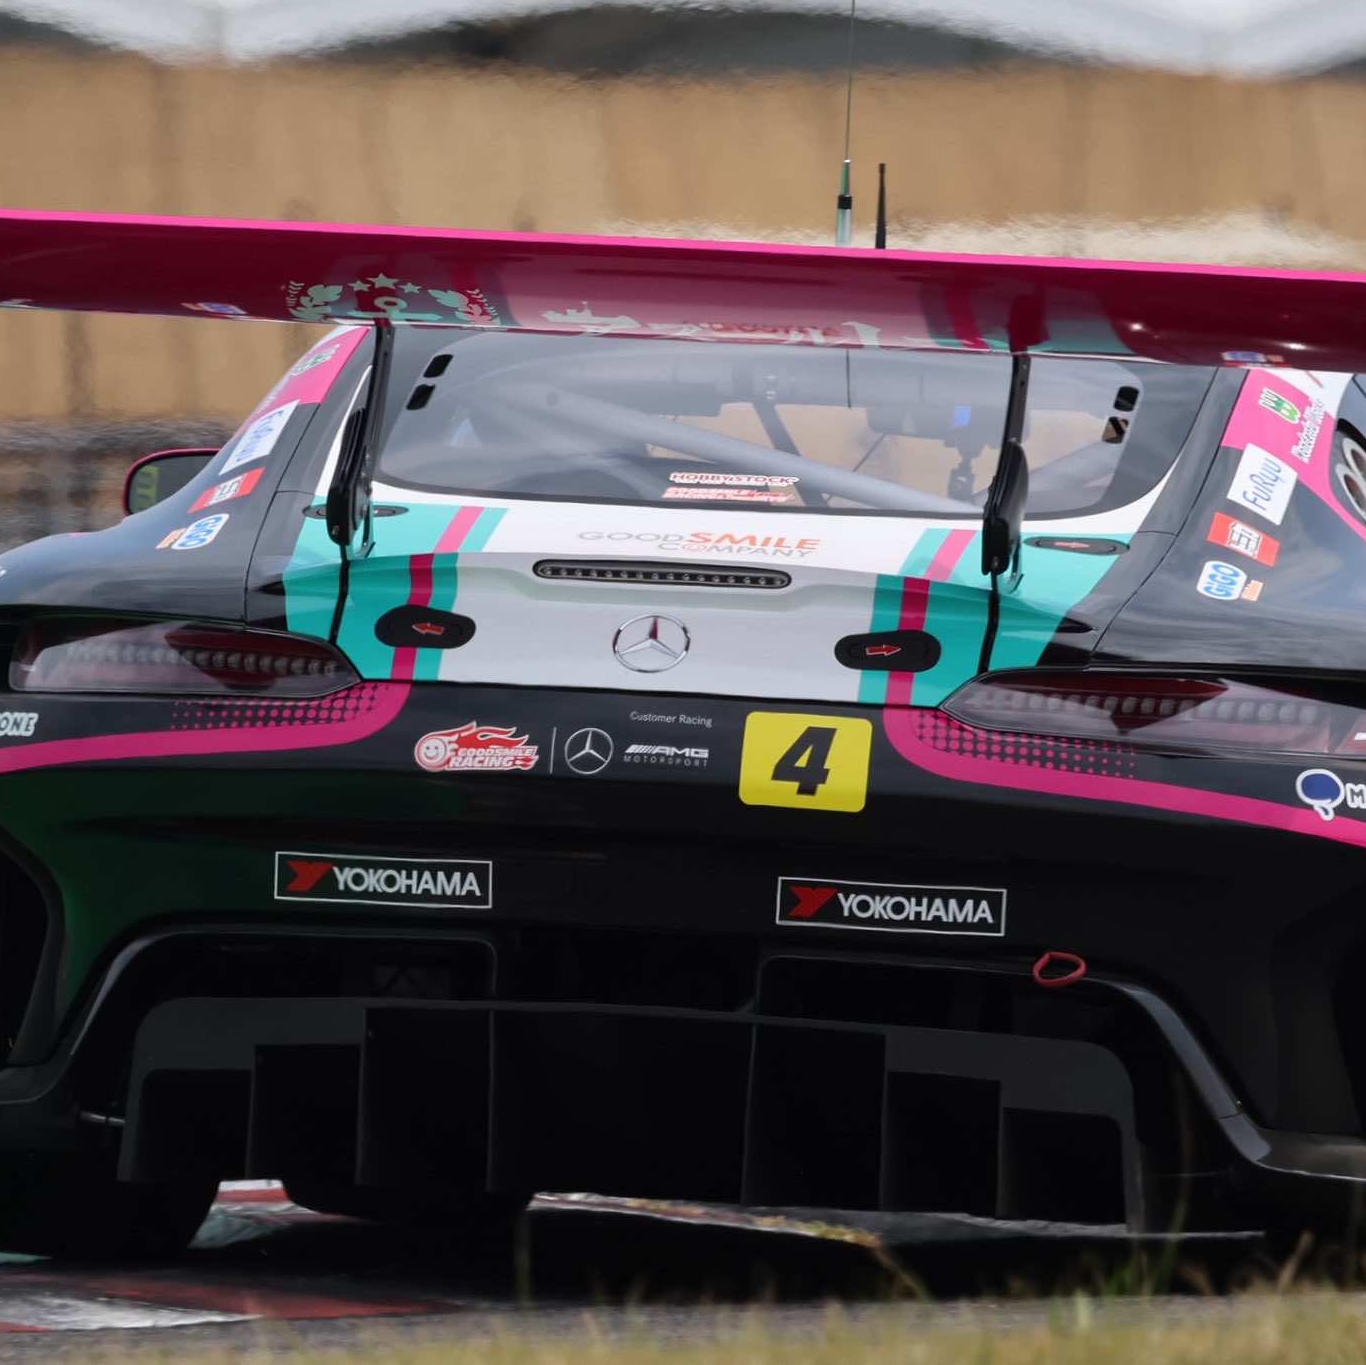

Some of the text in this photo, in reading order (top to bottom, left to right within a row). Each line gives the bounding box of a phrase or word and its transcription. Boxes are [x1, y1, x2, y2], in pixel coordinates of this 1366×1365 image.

[630, 711, 713, 728] Customer Racing
[457, 747, 534, 757] GOODSMILE
[449, 756, 514, 767] RACING
[623, 755, 708, 767] MOTORSPORT
[771, 726, 838, 797] 4
[332, 866, 482, 897] YOKOHAMA
[837, 892, 994, 924] YOKOHAMA
